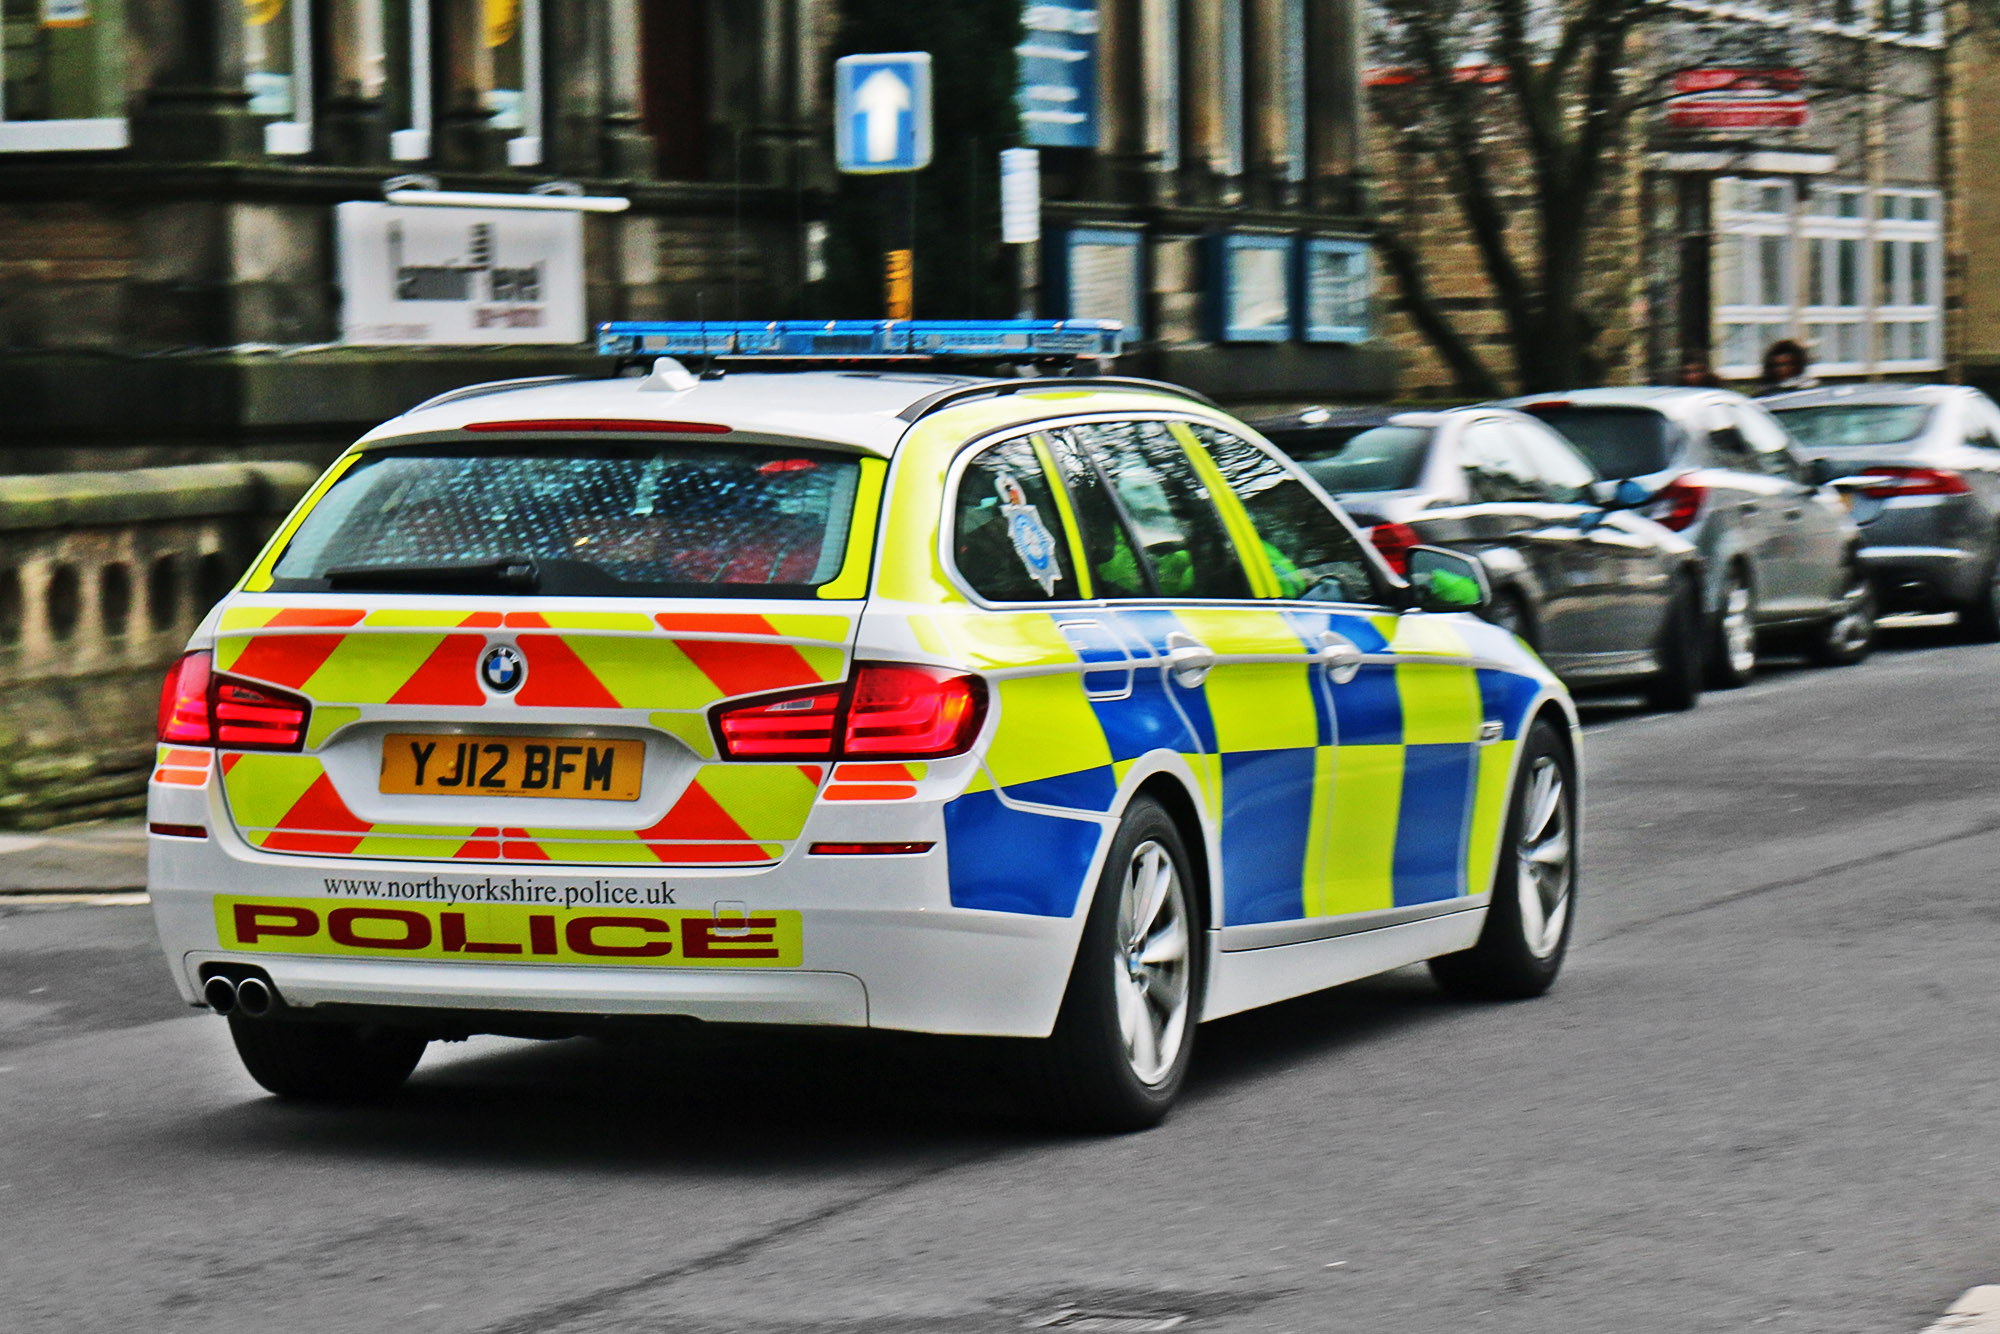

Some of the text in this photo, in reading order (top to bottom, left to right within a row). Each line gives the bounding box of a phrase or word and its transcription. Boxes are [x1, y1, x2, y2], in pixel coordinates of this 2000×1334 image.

[410, 741, 615, 792] YJ12 BFM
[324, 876, 676, 909] www.northyorkshire.police.uk
[235, 905, 778, 958] POLICE
